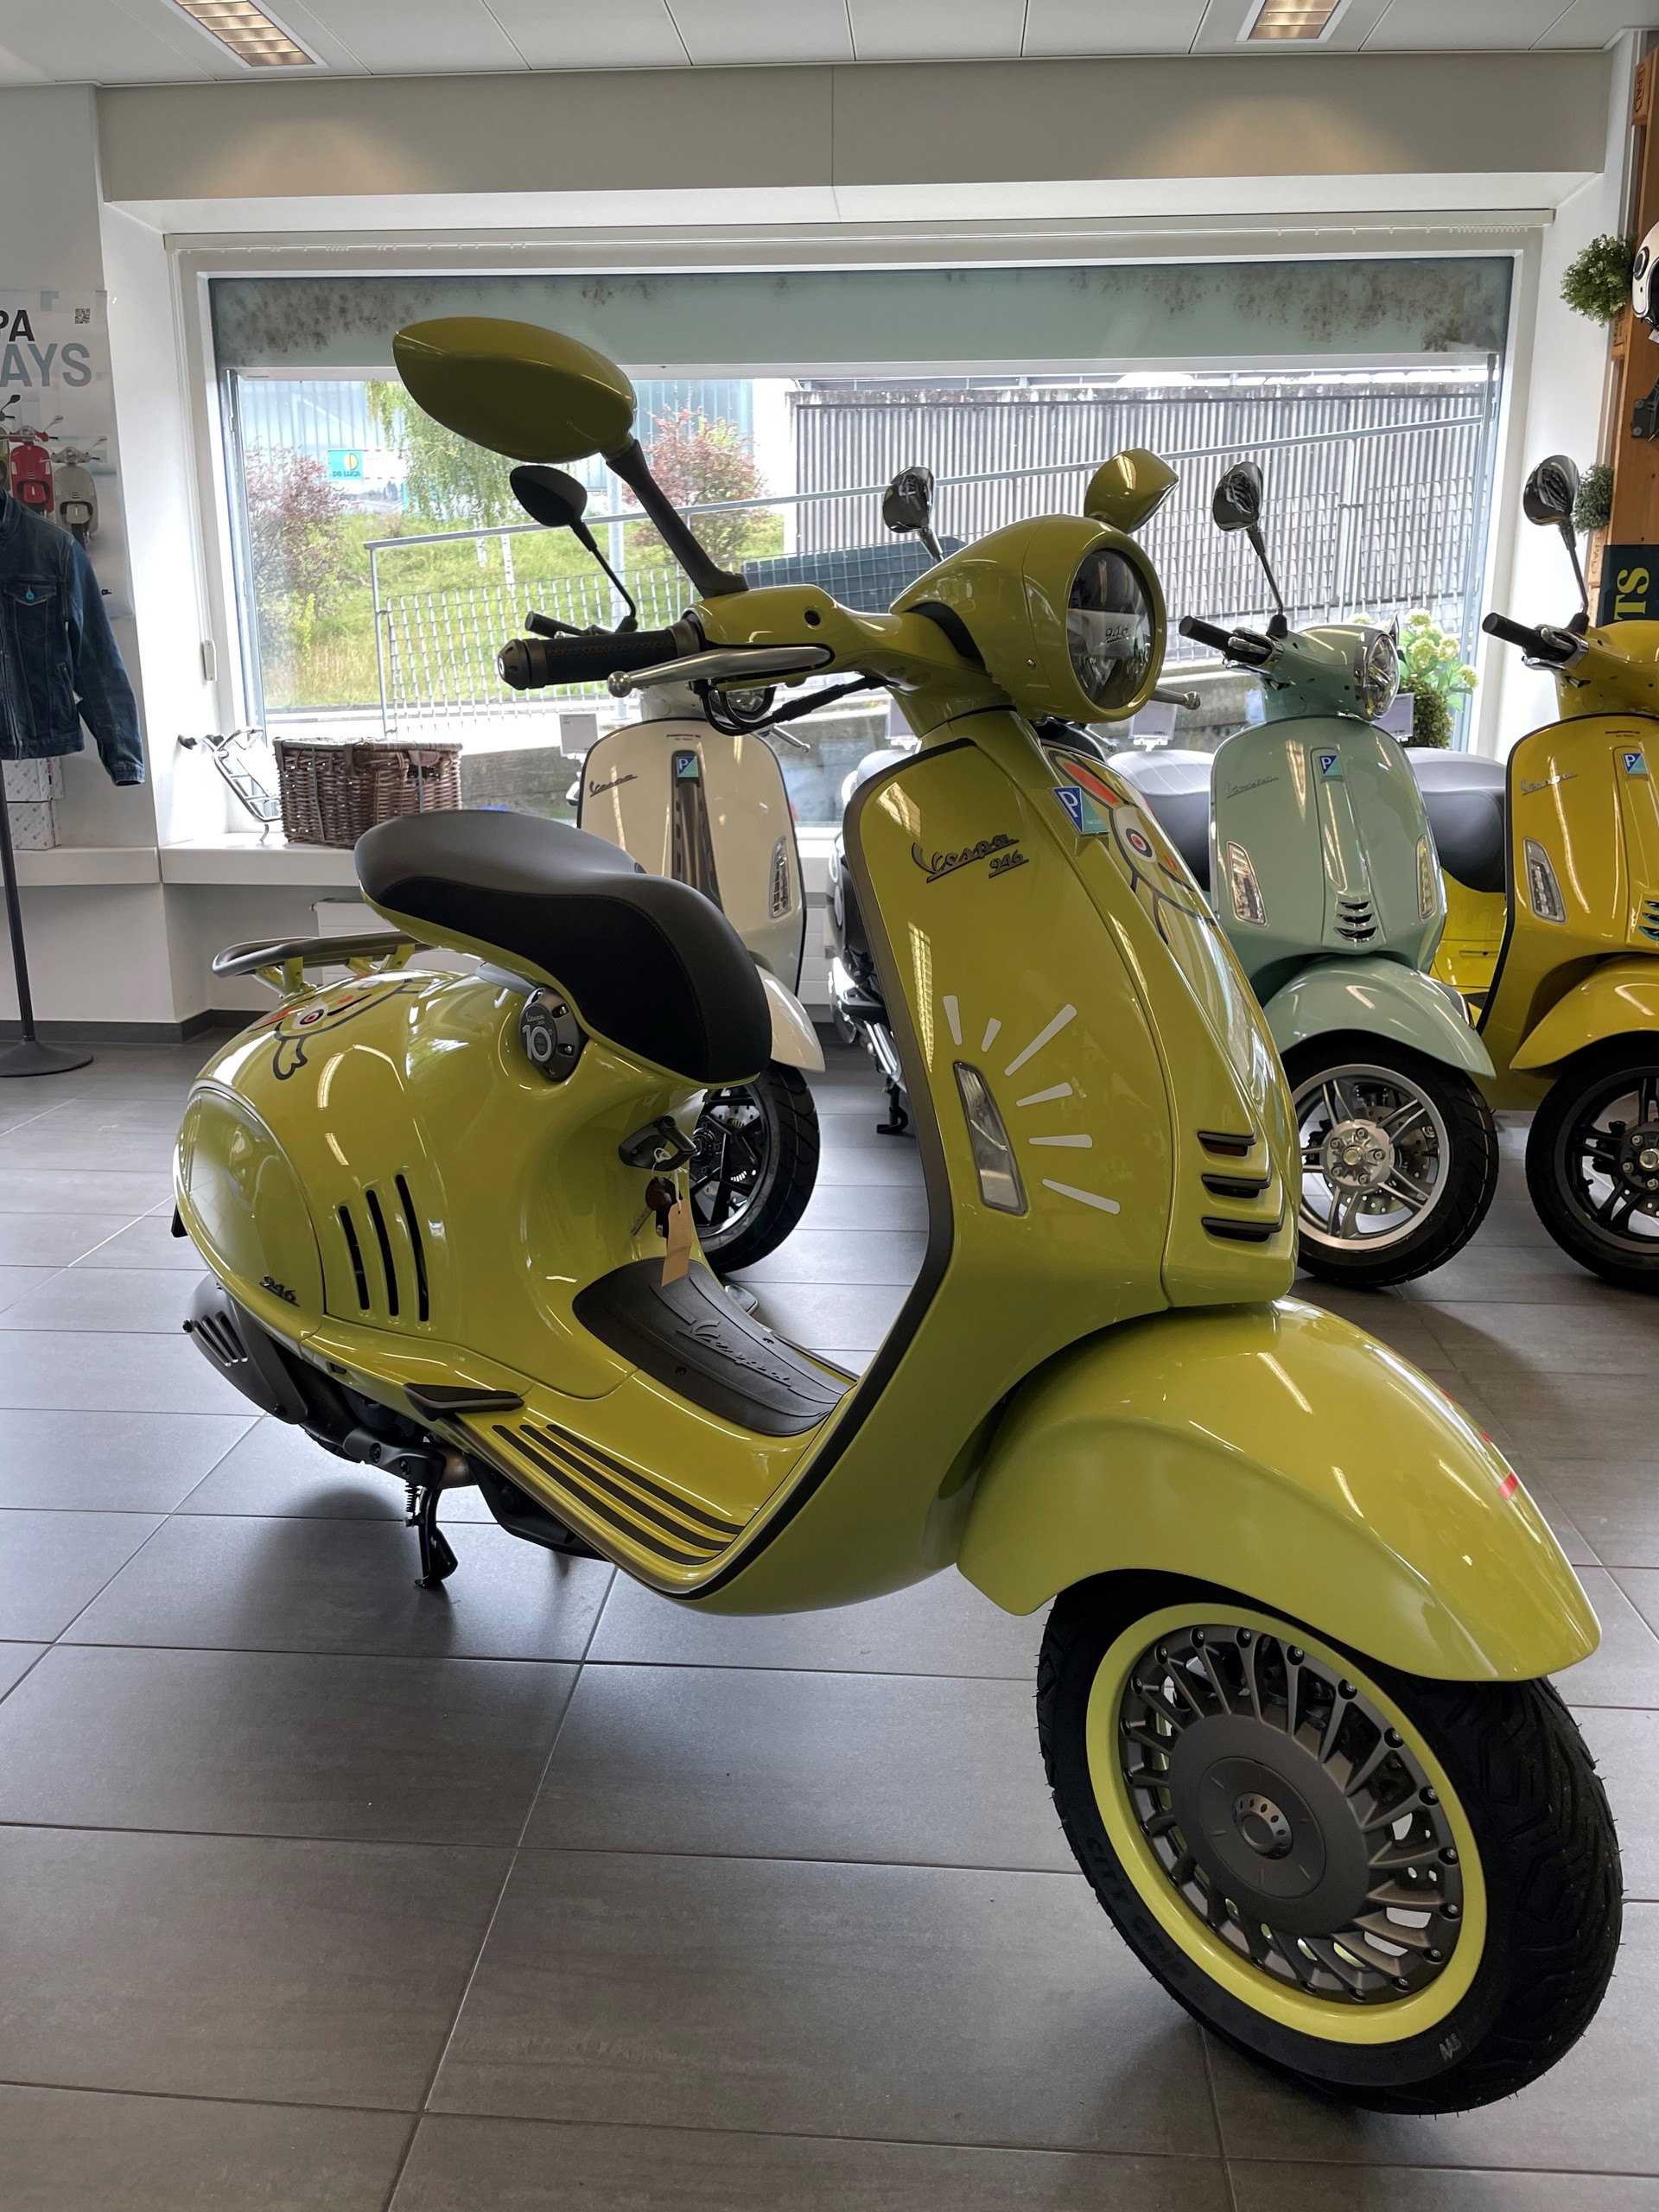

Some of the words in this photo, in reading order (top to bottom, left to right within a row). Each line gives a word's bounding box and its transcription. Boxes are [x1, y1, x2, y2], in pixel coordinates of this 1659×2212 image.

[0, 343, 92, 387] AYS
[1613, 567, 1649, 620] TS
[1105, 623, 1131, 644] 946
[1058, 791, 1079, 818] P
[912, 834, 1020, 884] Vespa
[988, 849, 1030, 879] 946
[259, 1274, 301, 1307] 946
[676, 1319, 792, 1388] Vespa
